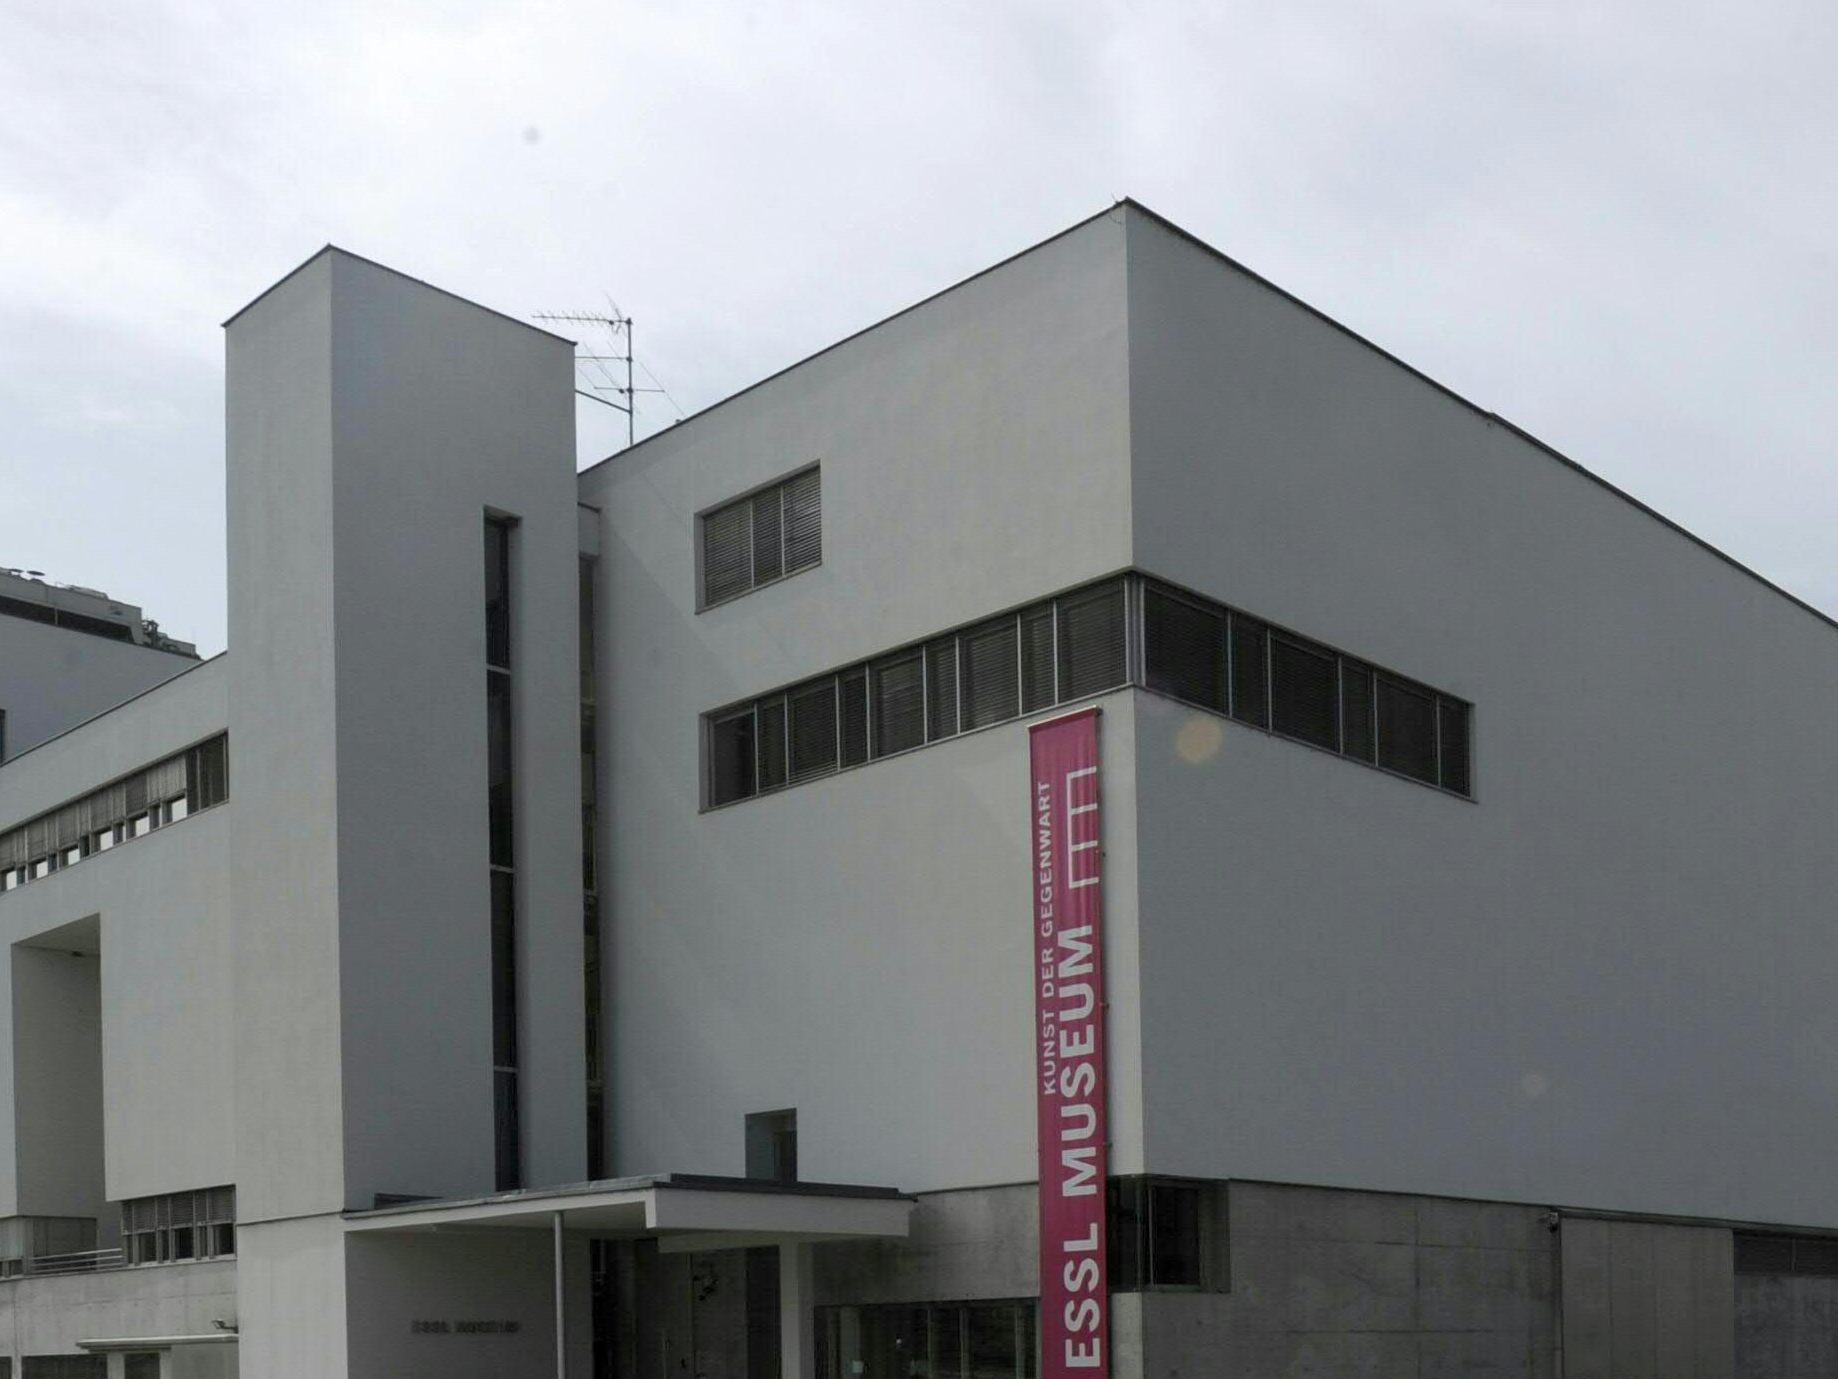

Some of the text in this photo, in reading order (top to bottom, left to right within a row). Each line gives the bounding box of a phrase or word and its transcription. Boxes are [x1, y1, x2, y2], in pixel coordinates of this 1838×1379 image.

[1037, 782, 1056, 1095] KUNST DER GEGENWART
[1057, 924, 1101, 1368] ESSL MUSEUM
